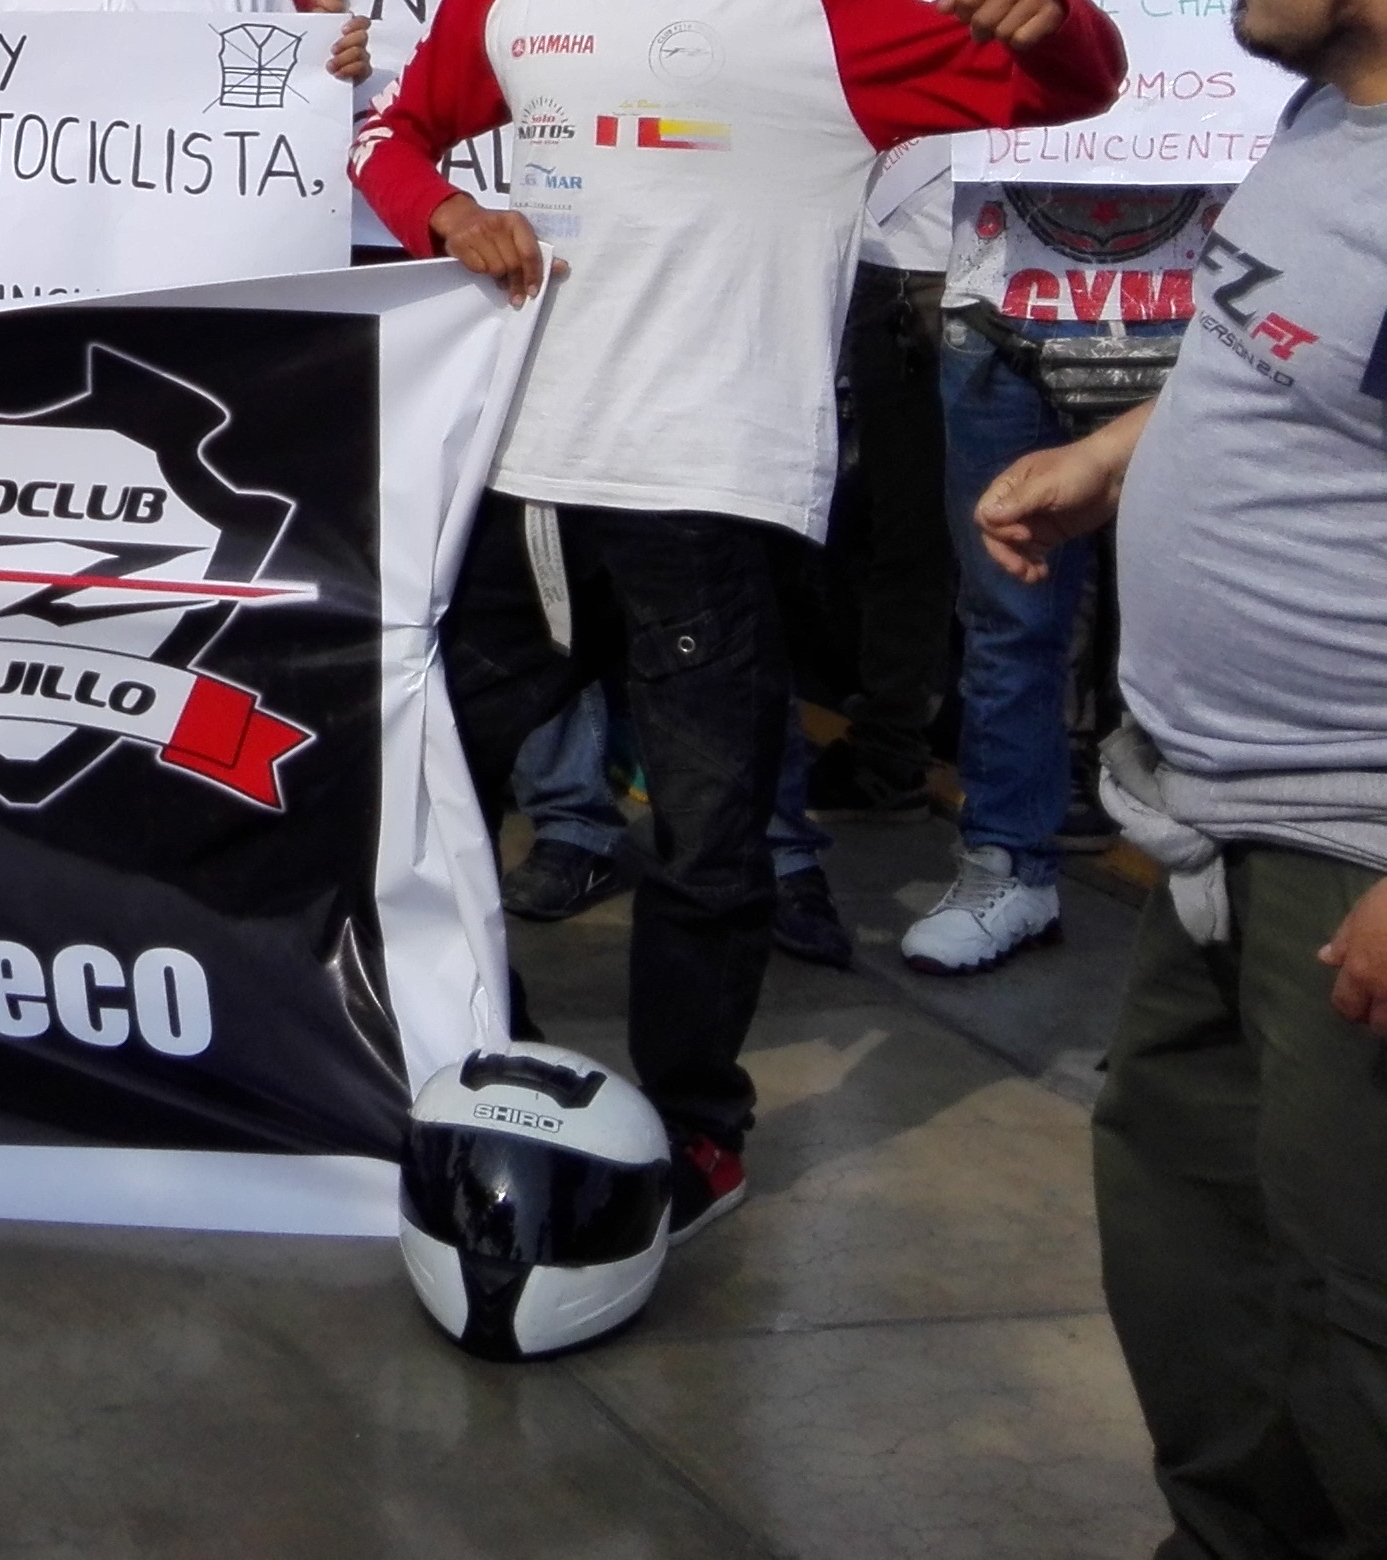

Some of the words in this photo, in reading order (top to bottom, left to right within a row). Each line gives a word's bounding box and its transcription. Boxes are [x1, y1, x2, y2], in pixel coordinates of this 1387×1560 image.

[529, 35, 594, 54] YAMAHA
[545, 176, 583, 189] MAR
[1199, 311, 1255, 367] VERSION
[1255, 359, 1295, 388] 2.0
[474, 1103, 560, 1133] SHIRO
